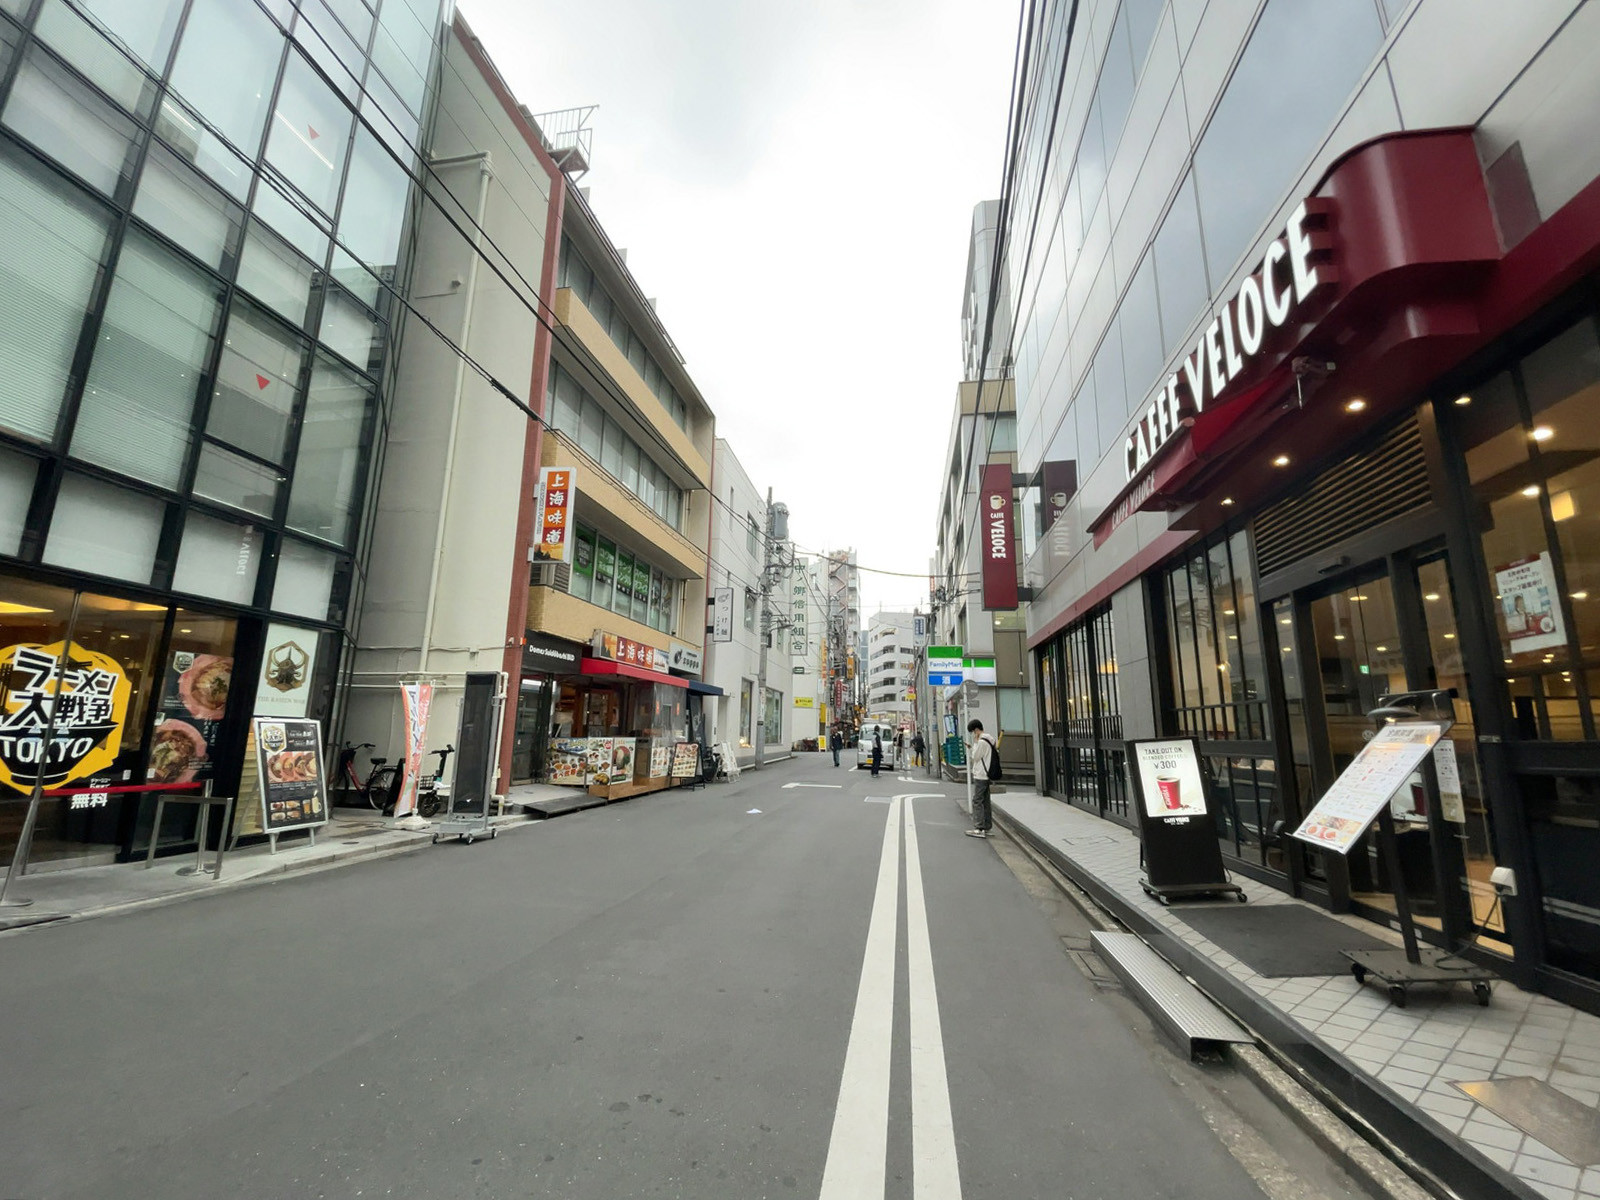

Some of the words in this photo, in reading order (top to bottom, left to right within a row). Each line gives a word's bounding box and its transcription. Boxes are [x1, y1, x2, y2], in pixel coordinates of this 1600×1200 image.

[1184, 200, 1319, 413] VELOCE
[546, 473, 565, 545] 上海味道
[990, 520, 1007, 559] VELOCE
[13, 646, 119, 697] ラーメン
[929, 660, 962, 669] FamilyMart
[2, 690, 114, 729] 大戦争
[0, 734, 94, 763] TOKYO
[70, 792, 108, 810] 無料
